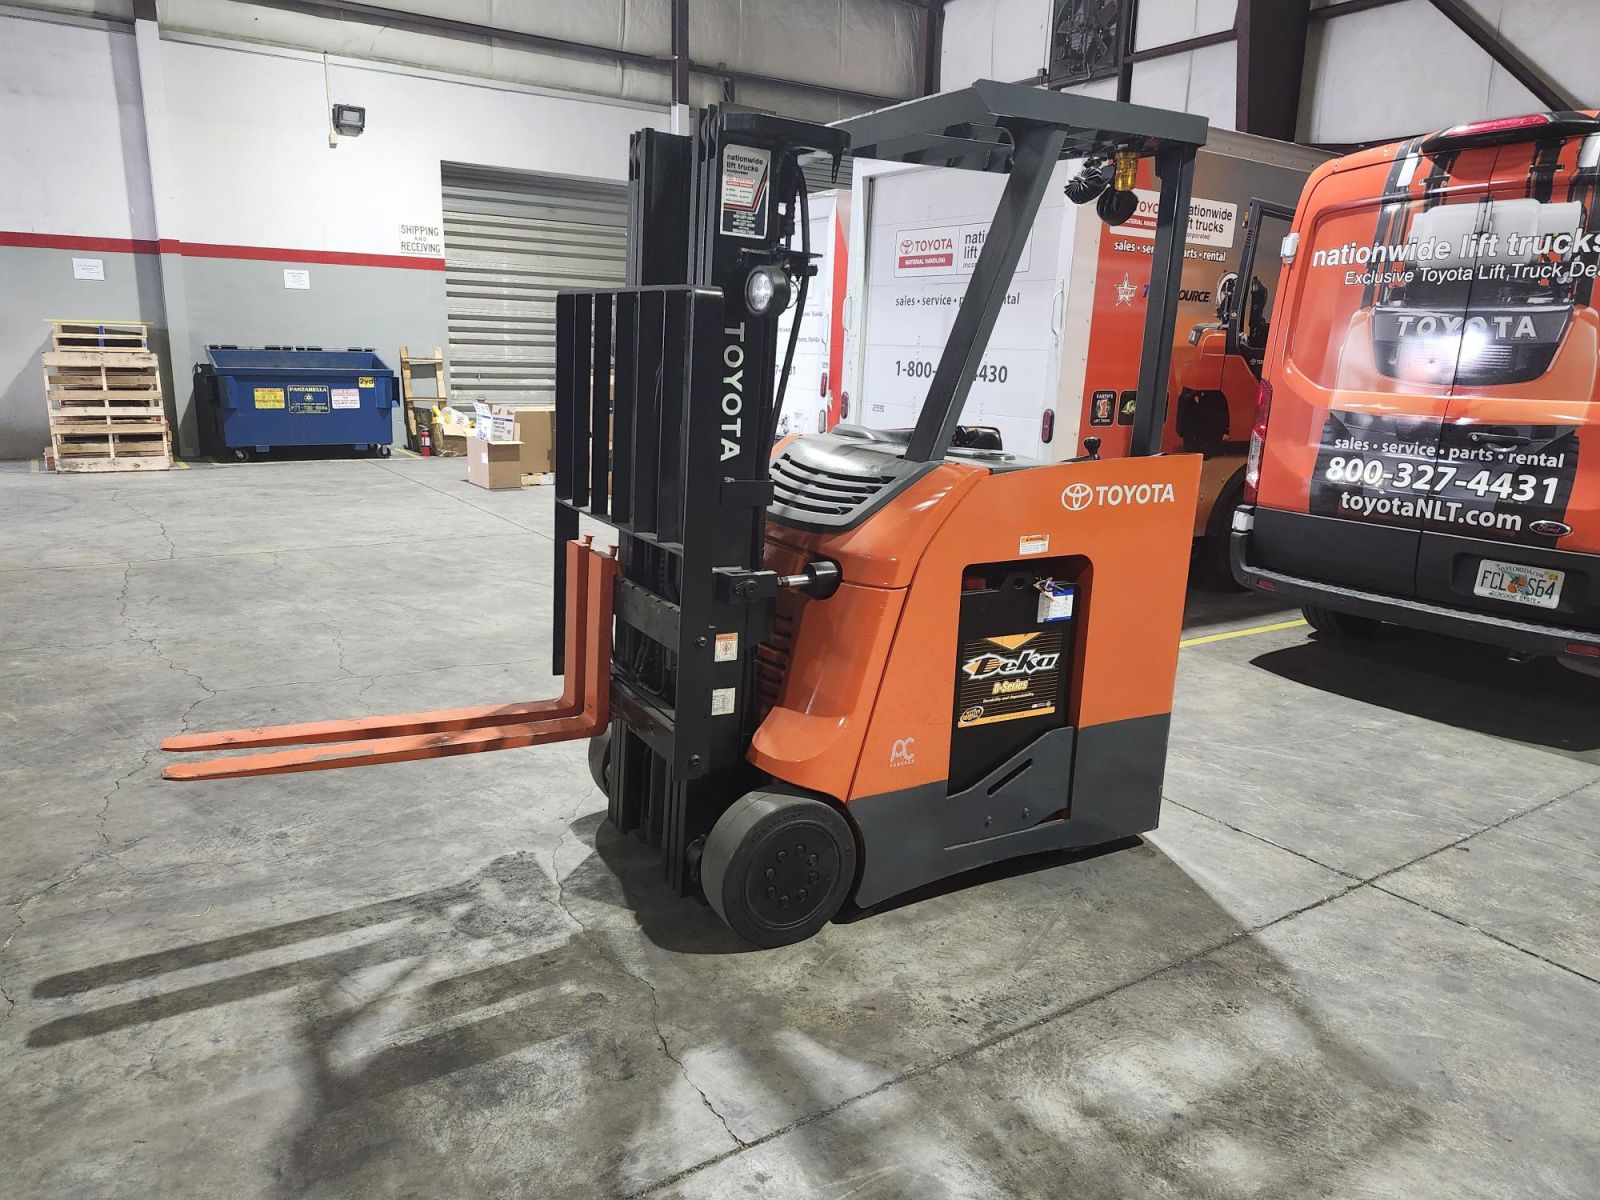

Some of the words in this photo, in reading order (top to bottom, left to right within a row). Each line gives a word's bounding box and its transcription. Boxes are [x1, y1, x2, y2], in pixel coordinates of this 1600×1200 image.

[727, 154, 763, 165] nationwide
[738, 163, 759, 172] trucks
[1190, 204, 1233, 221] ationwide
[400, 224, 439, 236] SHIPPING
[1195, 219, 1224, 233] trucks
[964, 230, 987, 245] nati
[1187, 232, 1210, 240] orporated
[400, 241, 441, 254] RECEIVING
[915, 238, 953, 252] TOYOTA
[963, 245, 977, 259] lift
[1114, 240, 1136, 252] sales
[1142, 244, 1154, 254] ser
[1312, 236, 1452, 267] nationwide
[1459, 232, 1499, 258] lift
[1507, 227, 1600, 256] trucks
[1203, 251, 1226, 262] rental
[1344, 269, 1414, 285] Exclusive
[1419, 265, 1473, 285] Toyota
[1479, 264, 1506, 280] Lift
[1511, 260, 1562, 279] Truck
[1569, 260, 1600, 278] De
[895, 295, 915, 306] sales
[921, 294, 952, 306] service
[1178, 289, 1211, 303] OURCE
[359, 378, 374, 386] 2yd
[720, 321, 745, 461] TOYOTA
[1334, 436, 1370, 451] sales
[1381, 441, 1436, 457] service
[1448, 447, 1493, 462] parts
[1508, 453, 1565, 468] rental
[1325, 456, 1559, 505] 800-327-4431
[1095, 483, 1175, 506] TOYOTA
[1341, 491, 1522, 531] toyotaNLT.com
[1480, 570, 1507, 591] FCL
[1525, 577, 1556, 600] S64
[1519, 595, 1537, 604] STATE
[962, 648, 1060, 680] Deka
